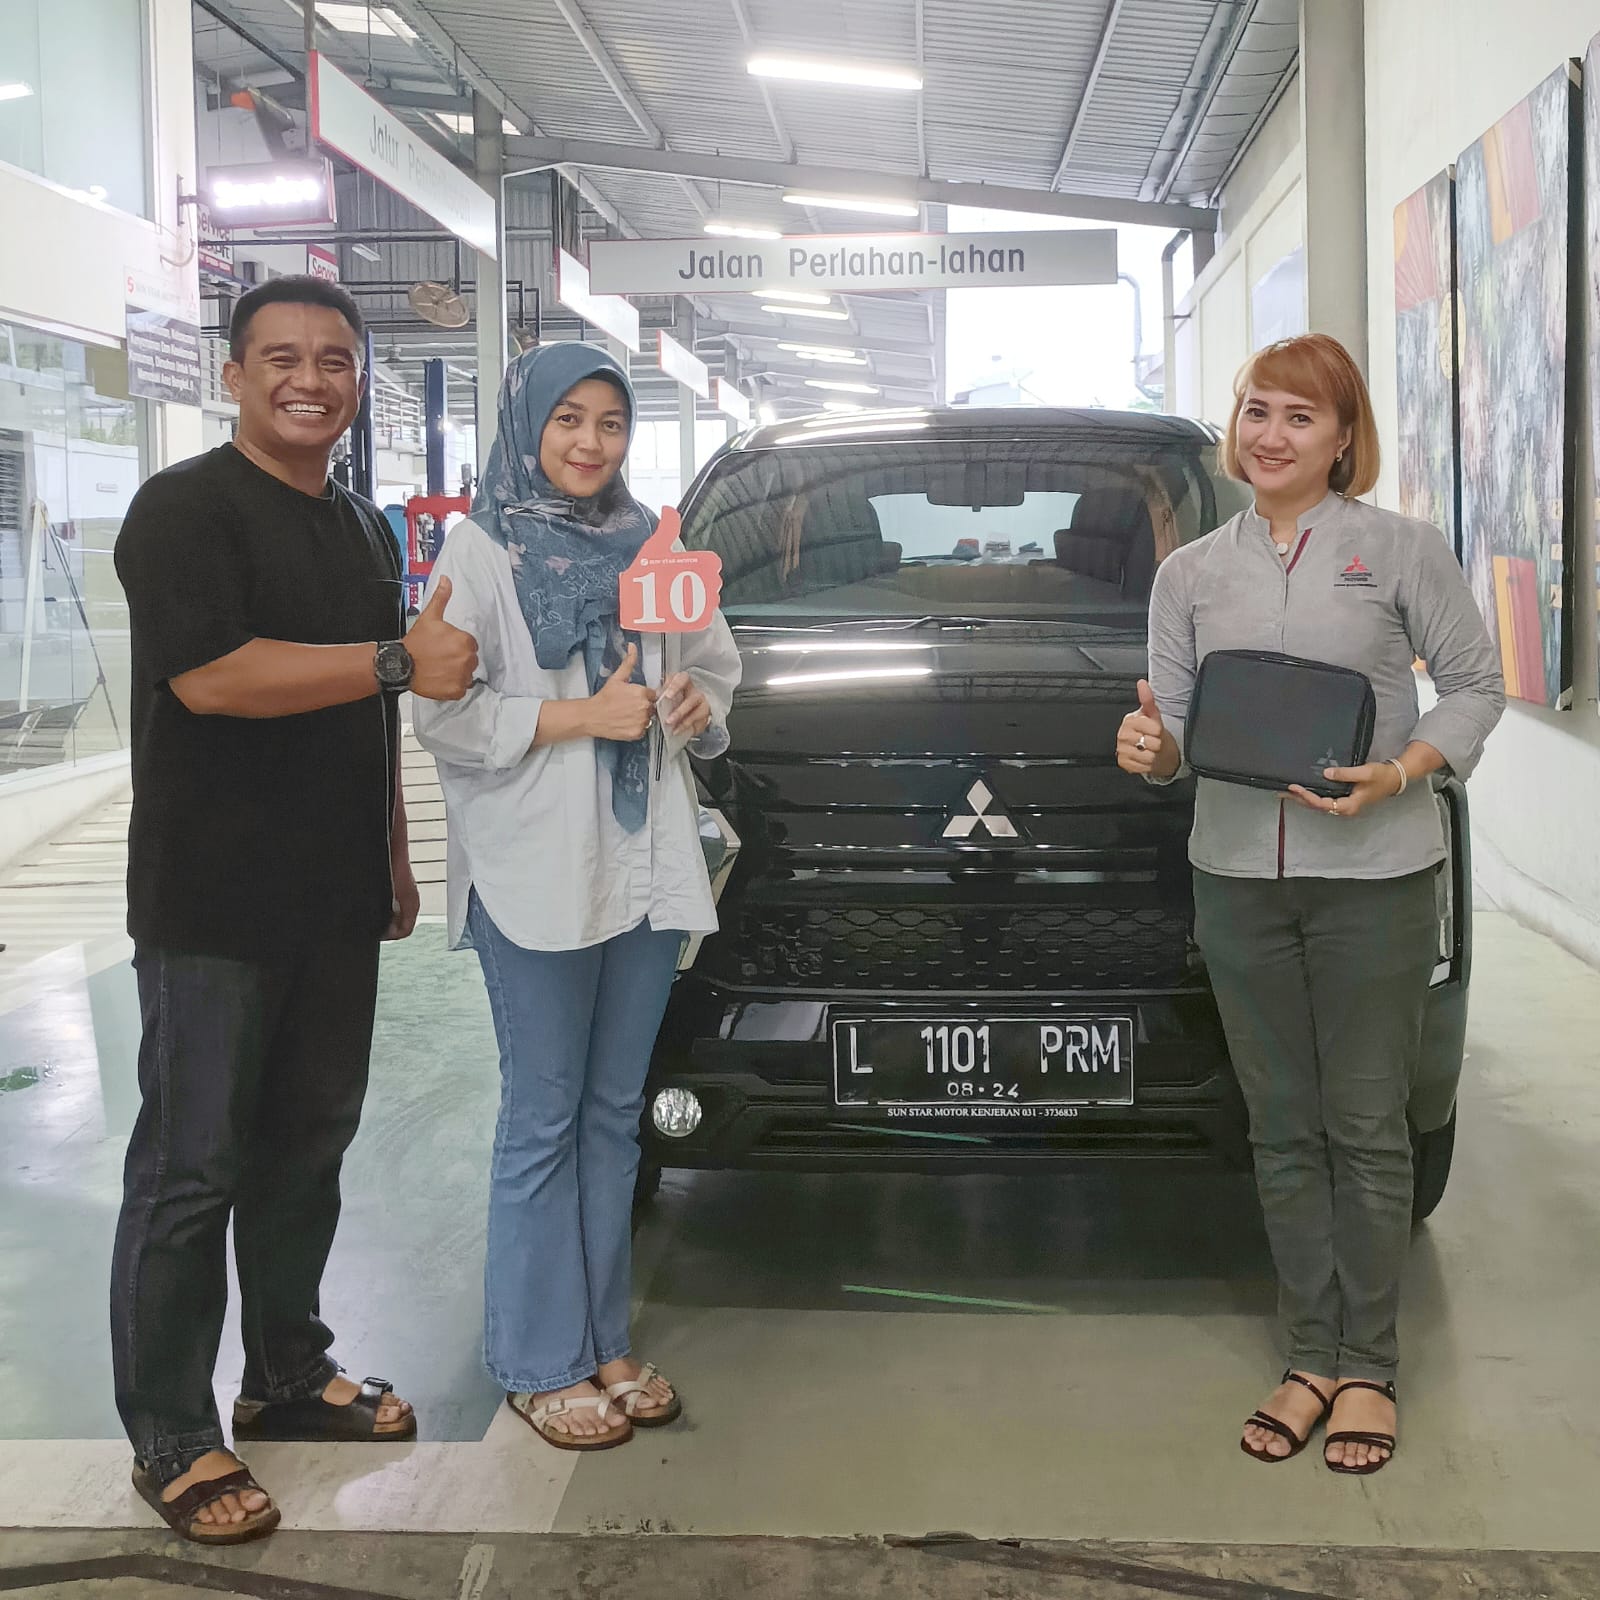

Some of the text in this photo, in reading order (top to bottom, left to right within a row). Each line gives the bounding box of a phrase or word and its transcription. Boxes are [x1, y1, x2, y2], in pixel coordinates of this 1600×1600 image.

[369, 114, 399, 172] Jalur
[678, 243, 1025, 280] Jalan Perlahan-lahan
[632, 570, 707, 623] 10
[849, 1024, 1121, 1074] L 1101 PRM
[947, 1081, 974, 1097] 08
[992, 1082, 1019, 1098] 24
[887, 1108, 908, 1117] SUN
[908, 1108, 934, 1117] STAR
[934, 1108, 970, 1117] MOTOR
[970, 1108, 1021, 1117] KENJERAN
[1021, 1108, 1037, 1117] 031
